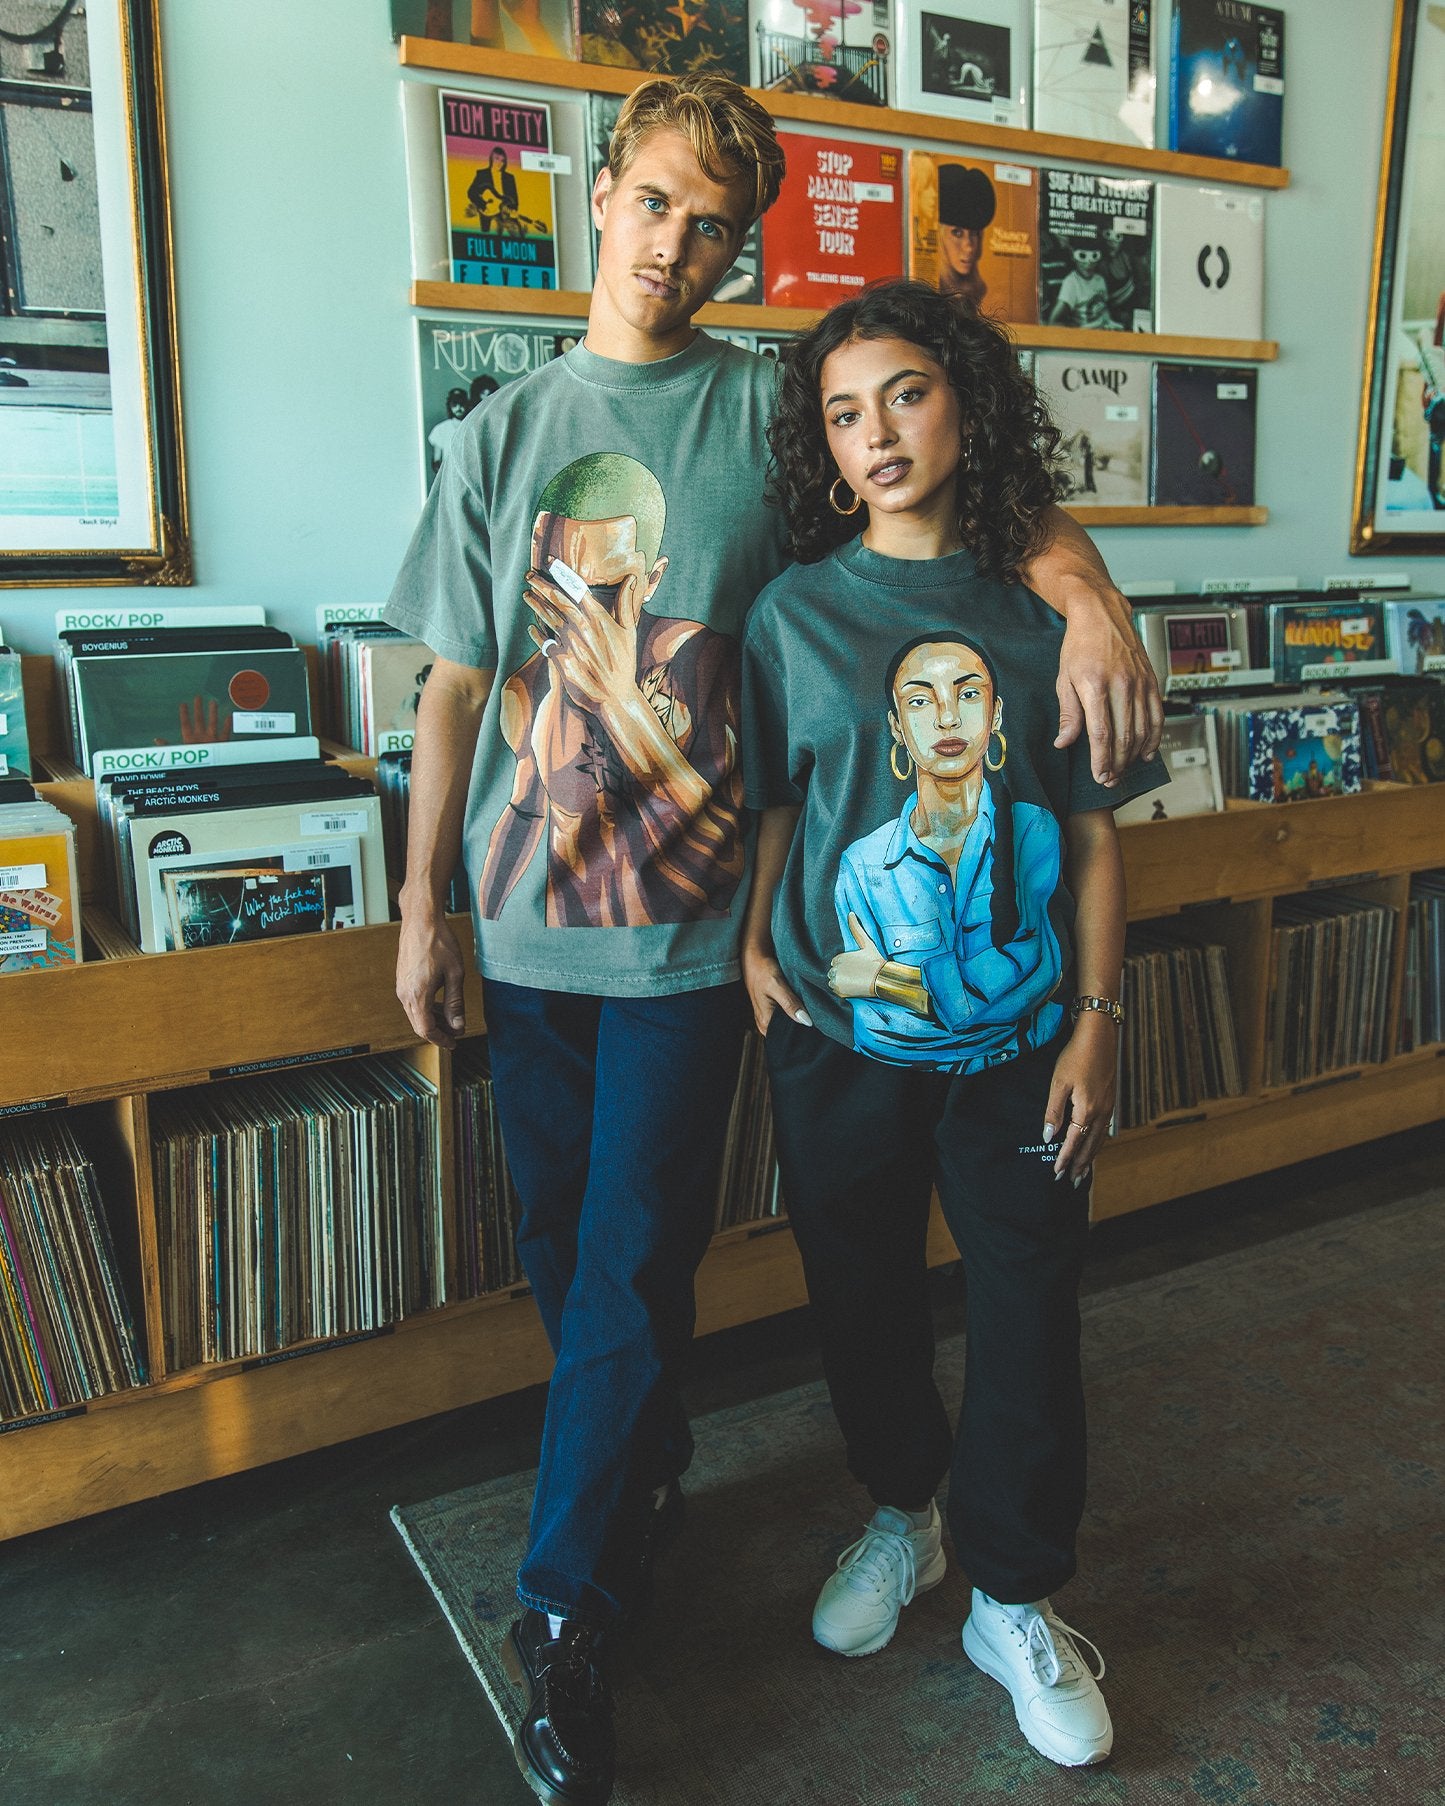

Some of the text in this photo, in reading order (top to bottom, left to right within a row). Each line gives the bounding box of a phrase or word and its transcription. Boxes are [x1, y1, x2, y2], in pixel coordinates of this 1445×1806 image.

[447, 101, 543, 144] TOM PETTY
[816, 150, 853, 176] STOP
[807, 174, 862, 204] MAKIN
[1048, 170, 1094, 195] SUFJAN
[1048, 192, 1148, 218] THE GREATEST GIFT
[814, 203, 859, 230] SENSE
[466, 236, 538, 262] FULL MOON
[816, 229, 855, 256] TOUR
[65, 613, 164, 629] ROCK/ POP
[324, 608, 373, 622] ROCK/
[81, 641, 128, 651] BOYGENIUS
[102, 749, 209, 770] ROCK/ POP
[114, 774, 139, 782] DAVID
[146, 786, 175, 794] BEACH
[176, 784, 199, 792] BOYS
[144, 796, 176, 806] ARCTIC
[178, 793, 220, 803] MONKEYS
[153, 844, 184, 854] MONKEYS
[157, 836, 183, 848] ARCTIC
[0, 891, 17, 905] he
[35, 890, 55, 905] Way
[1019, 1145, 1045, 1154] TRAIN
[1048, 1143, 1059, 1152] OF
